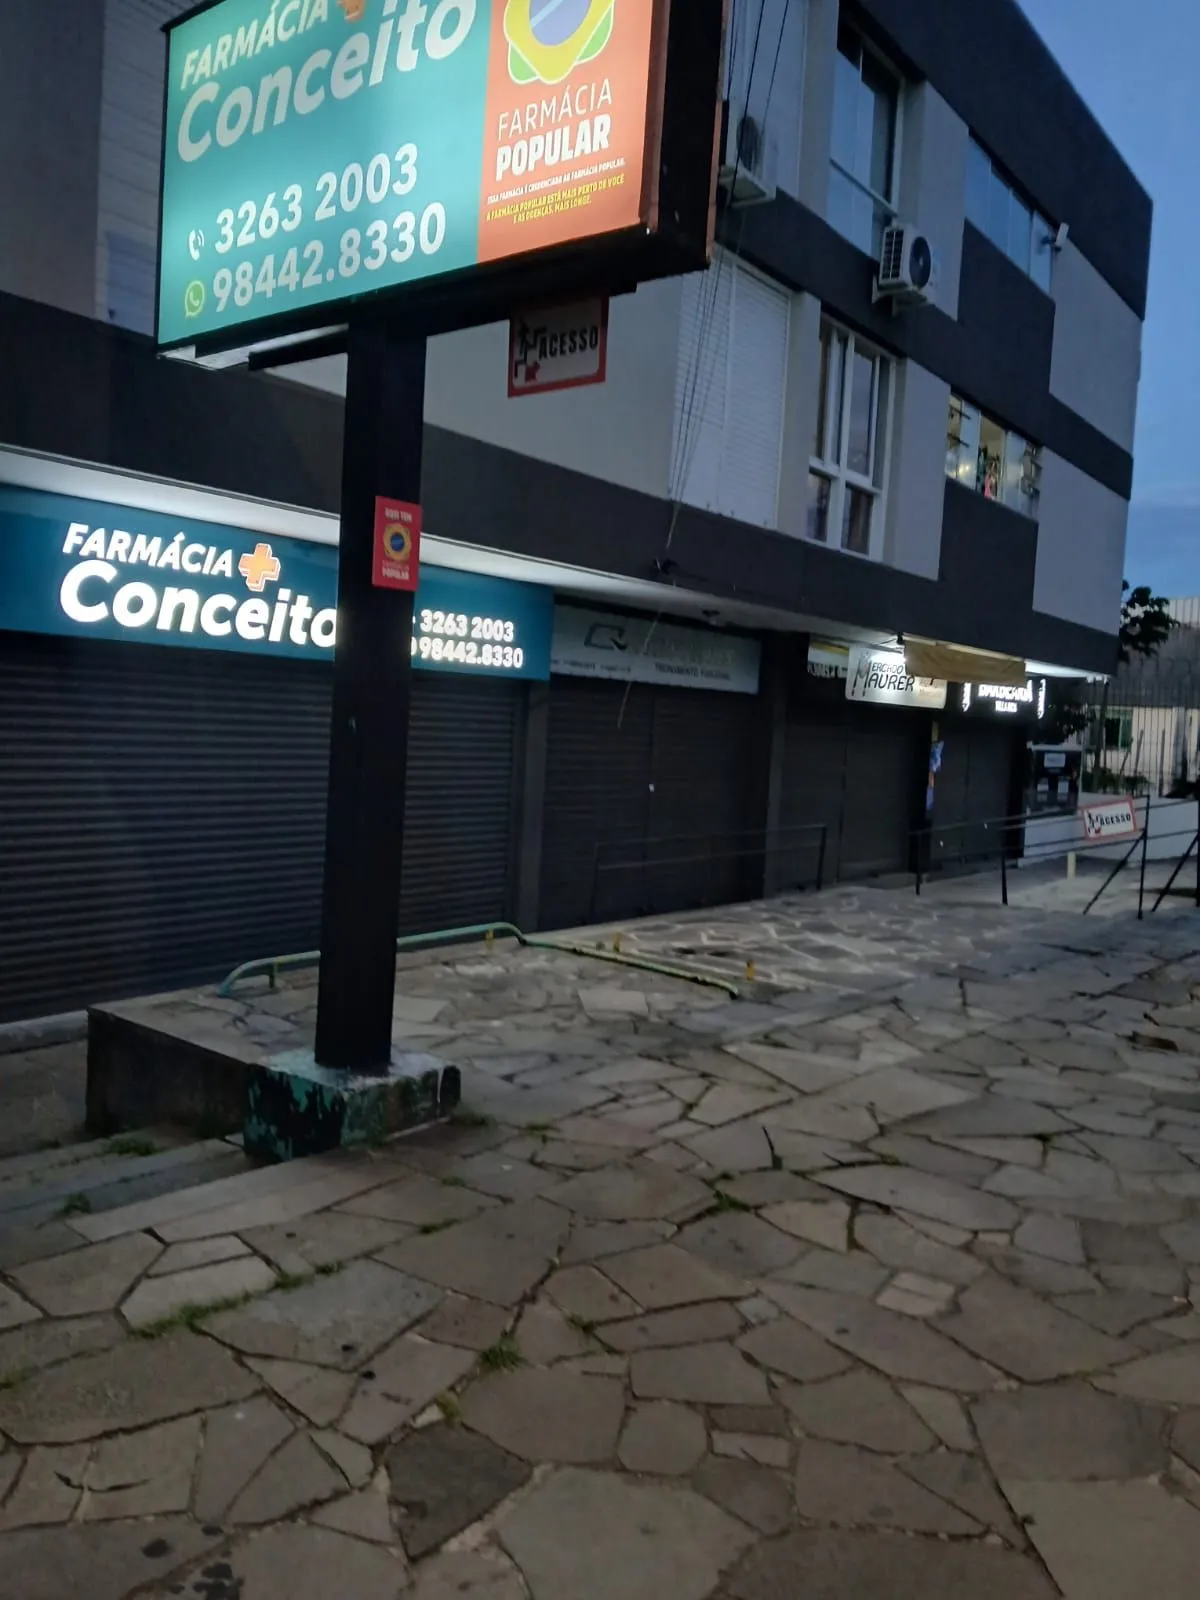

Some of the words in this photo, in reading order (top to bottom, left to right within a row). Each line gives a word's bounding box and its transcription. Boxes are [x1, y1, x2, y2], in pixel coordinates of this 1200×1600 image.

[180, 0, 328, 90] FARMÁCIA
[178, 0, 476, 162] Conceito
[498, 78, 612, 141] FARMÁCIA
[496, 114, 612, 182] POPULAR
[214, 183, 303, 254] 3263
[315, 143, 418, 221] 2003
[213, 201, 446, 312] 98442.8330
[539, 325, 599, 361] ACESSO
[62, 522, 233, 577] FARMÁCIA
[60, 559, 336, 648] Conceito
[420, 609, 468, 637] 3263
[470, 616, 514, 642] 2003
[419, 636, 523, 668] 98442.8330
